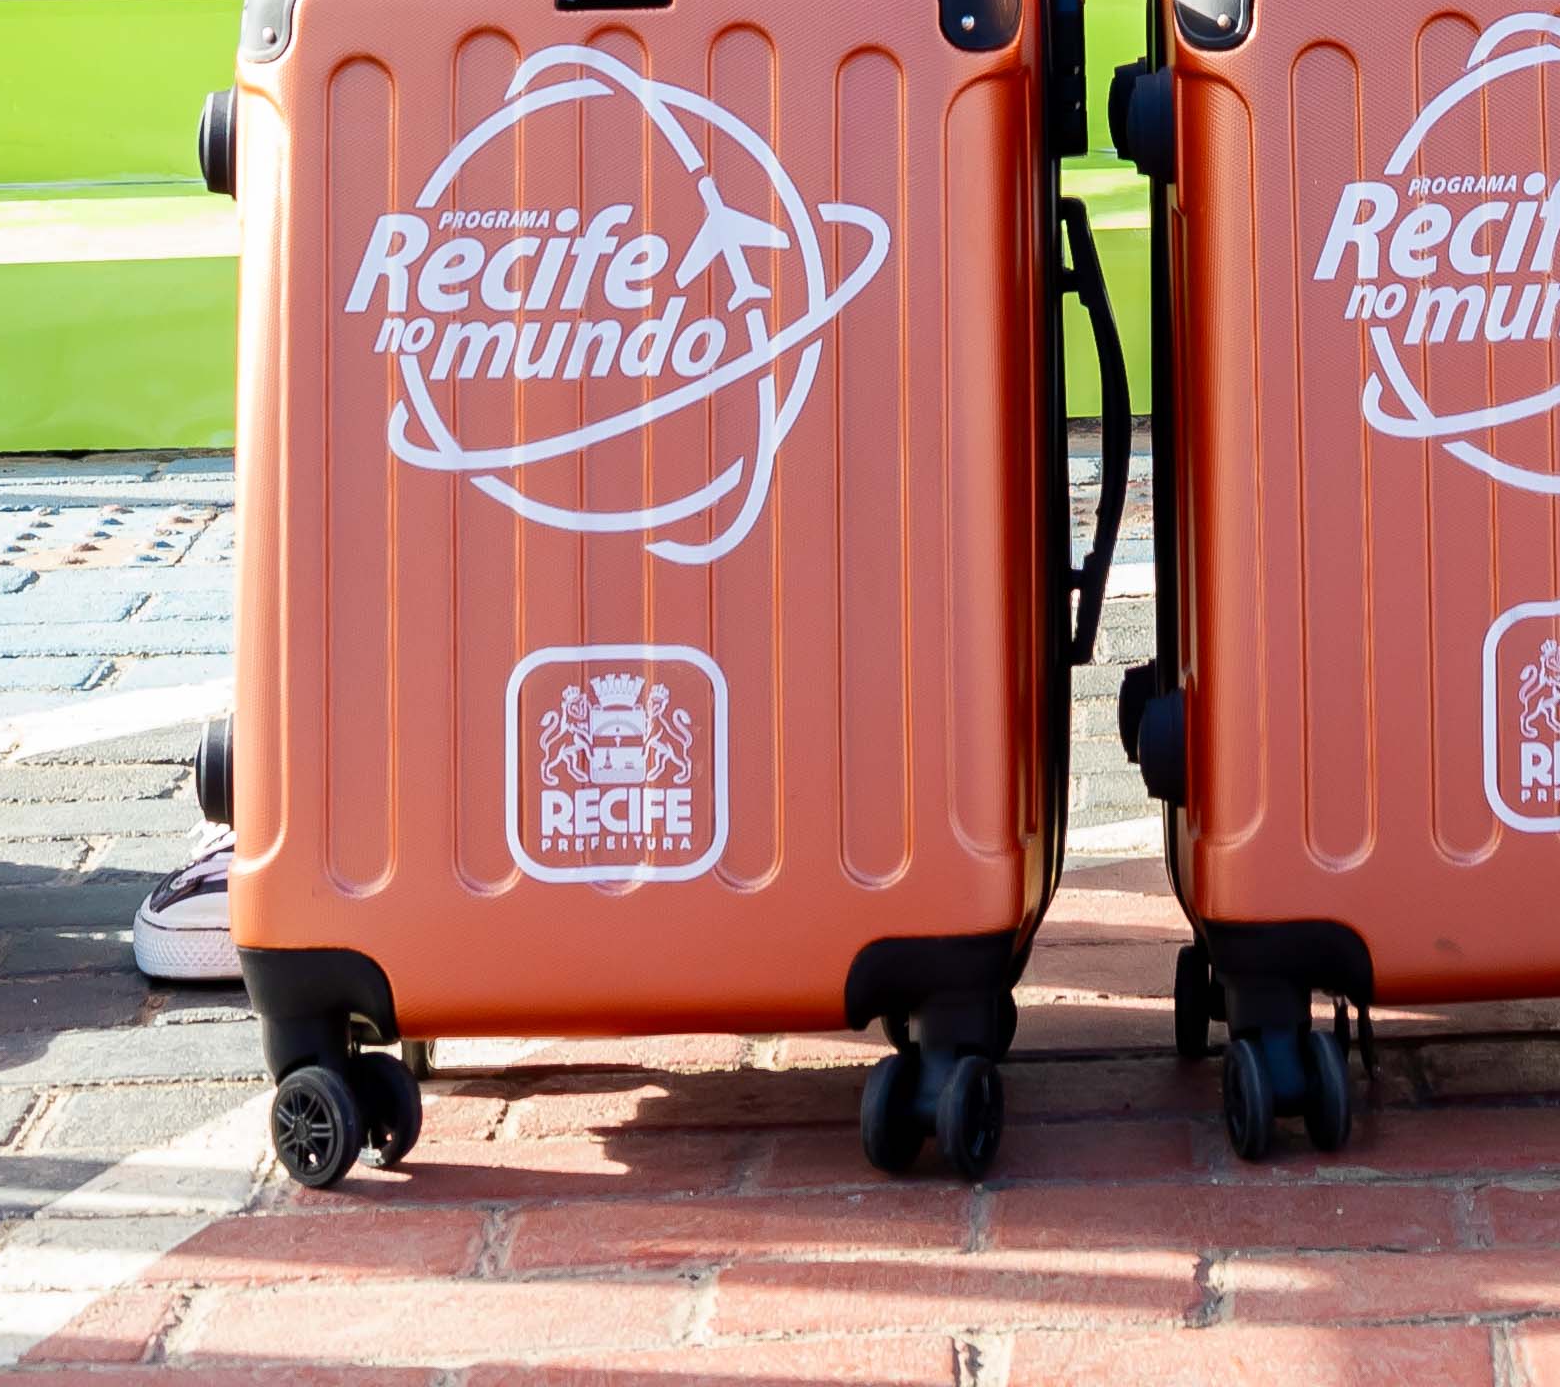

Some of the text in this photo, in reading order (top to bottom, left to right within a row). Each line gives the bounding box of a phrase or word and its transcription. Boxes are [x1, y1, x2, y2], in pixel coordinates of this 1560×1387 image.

[1407, 173, 1518, 196] PROGRAMA
[438, 210, 550, 230] PROGRAMA
[343, 204, 670, 313] Recife
[1344, 283, 1407, 320] no
[373, 296, 728, 382] no mundo
[540, 787, 693, 837] RECIFE
[540, 835, 693, 852] PREFEITURA
